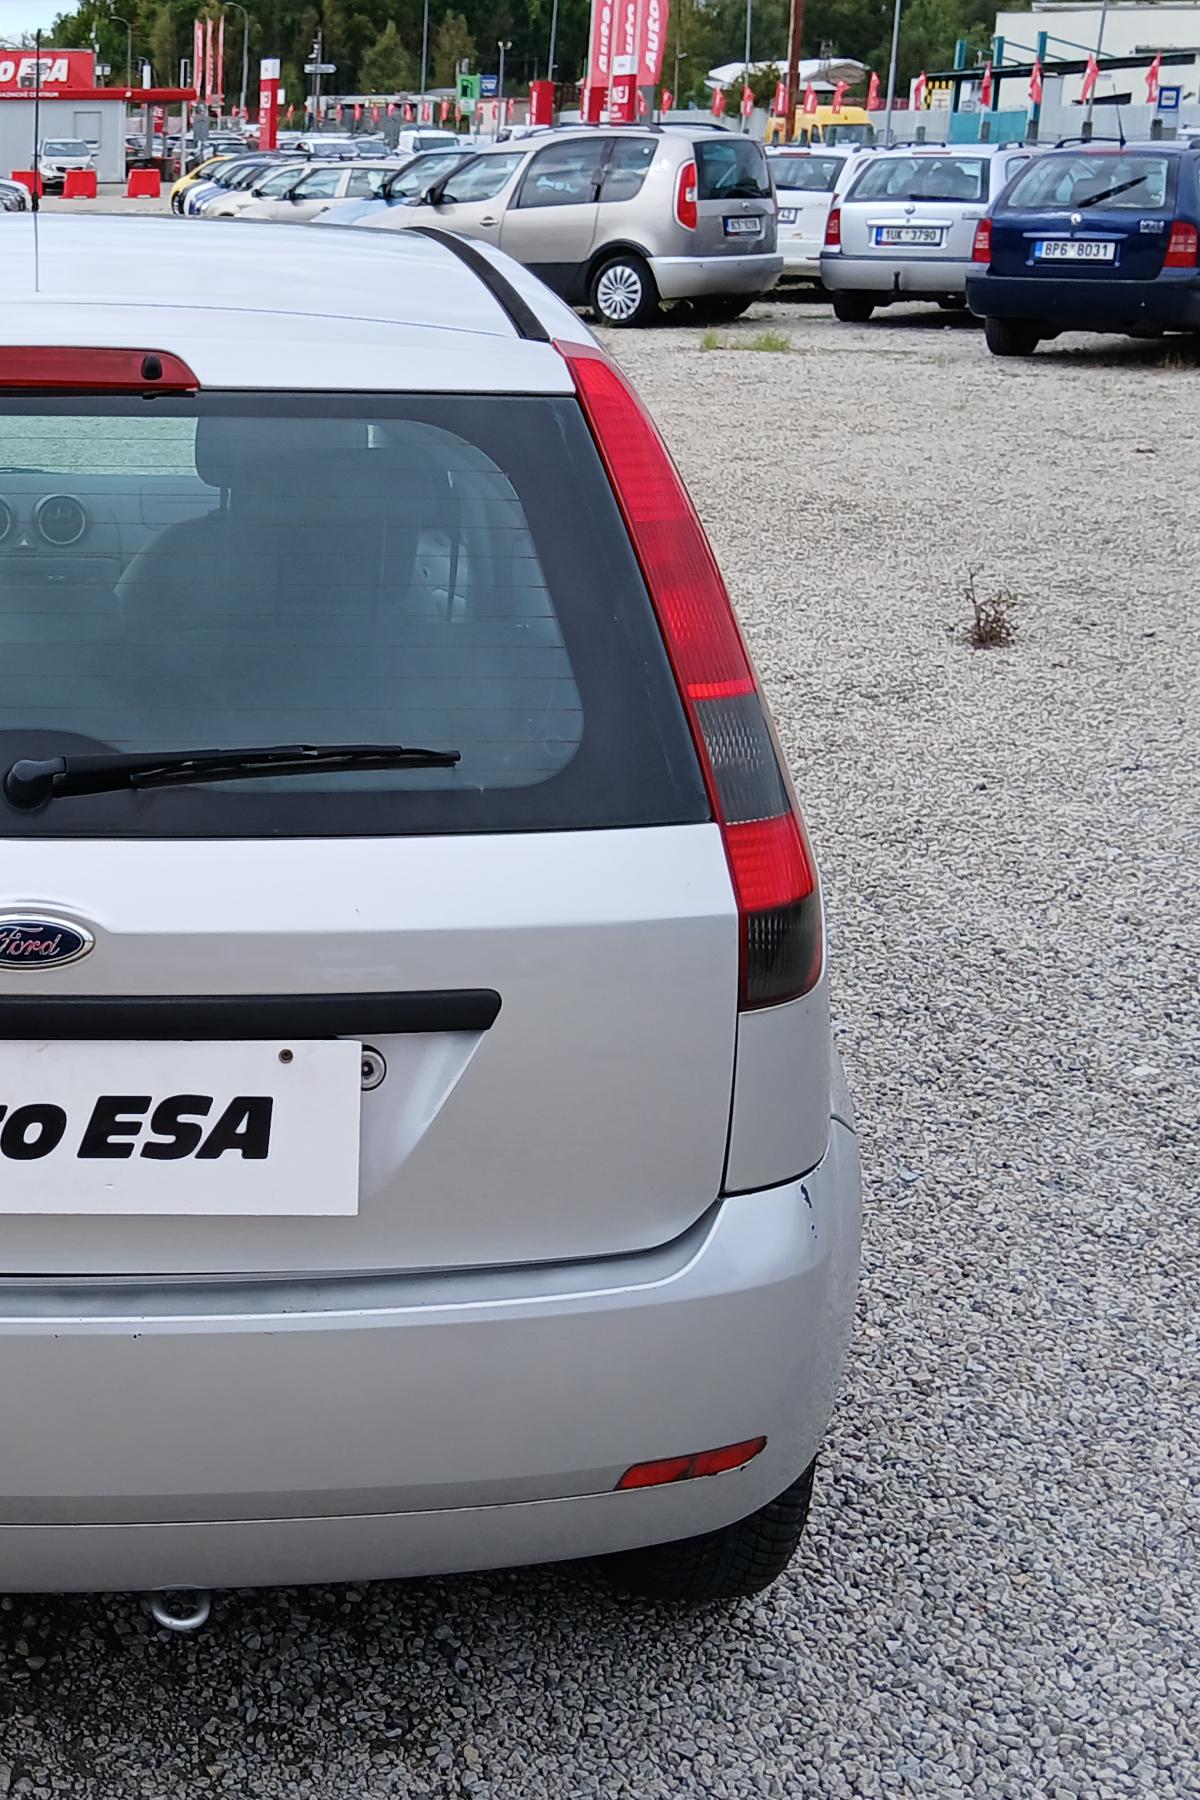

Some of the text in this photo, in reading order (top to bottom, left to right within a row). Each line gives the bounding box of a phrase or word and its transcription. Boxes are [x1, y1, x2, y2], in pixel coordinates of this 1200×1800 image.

[885, 229, 937, 241] 1UK 3790
[1076, 243, 1109, 257] 8031
[76, 1094, 274, 1161] ESA
